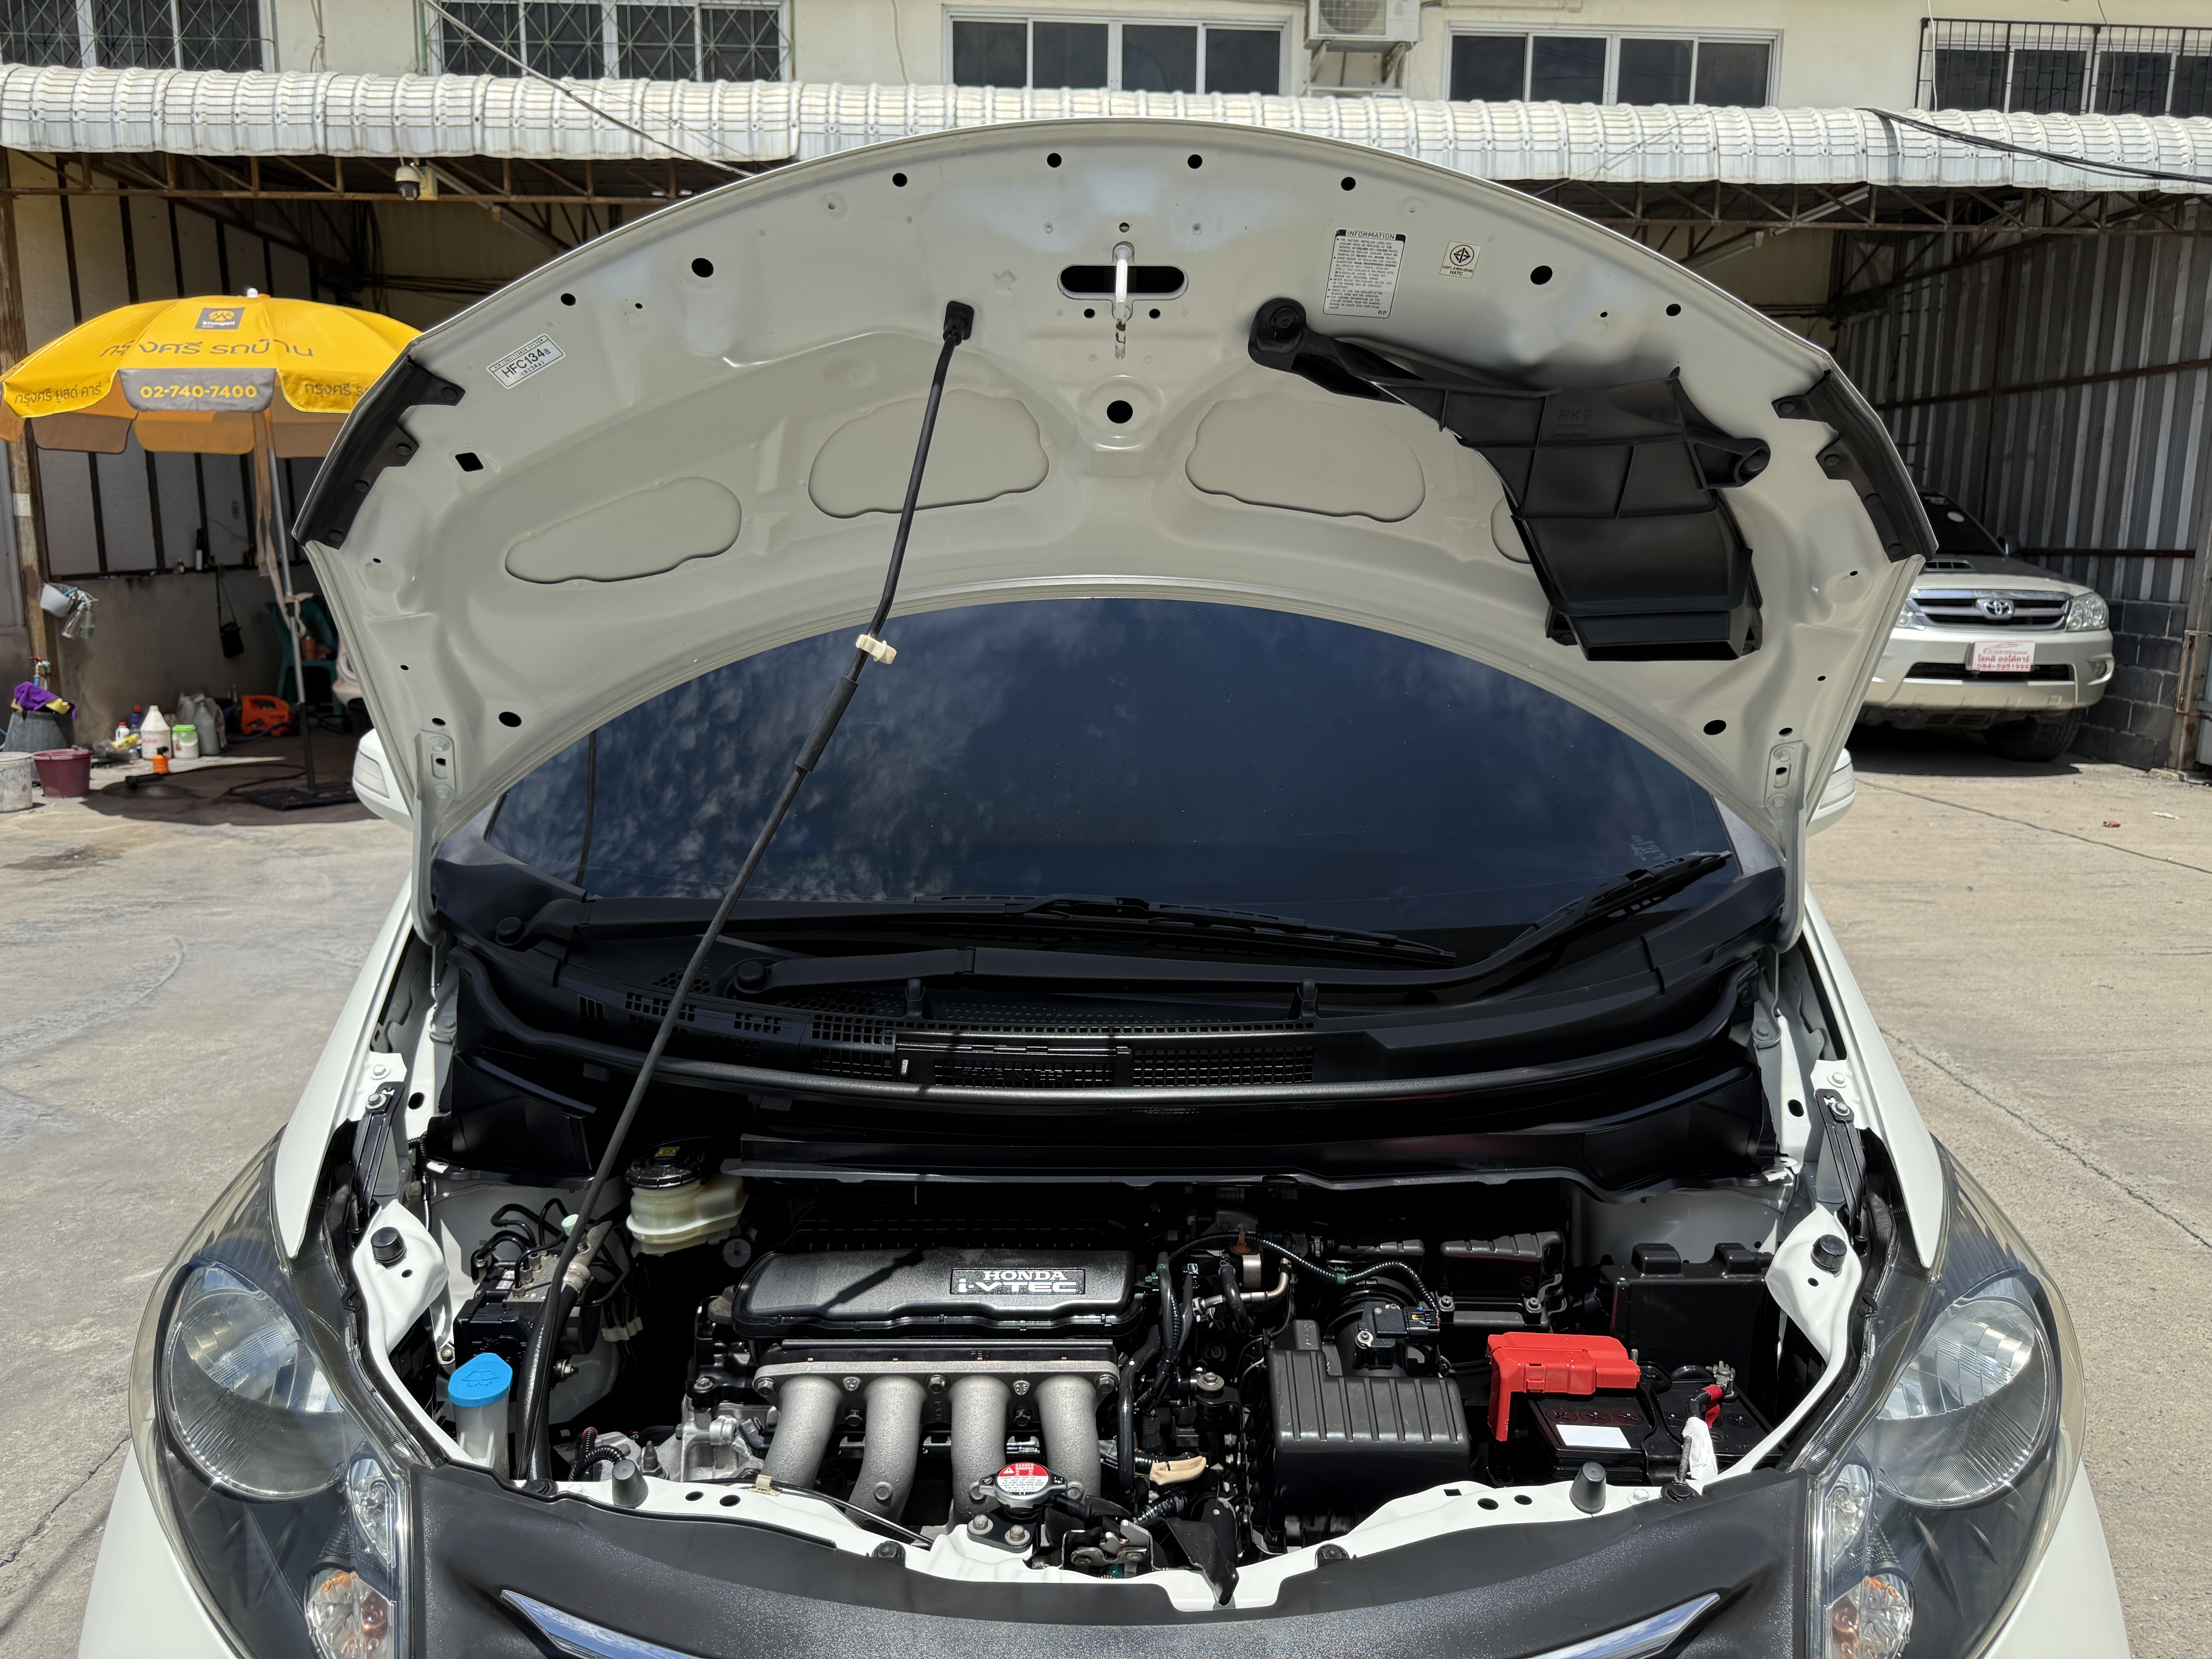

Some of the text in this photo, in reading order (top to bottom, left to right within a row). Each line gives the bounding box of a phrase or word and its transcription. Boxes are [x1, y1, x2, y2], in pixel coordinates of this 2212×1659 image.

[1347, 231, 1395, 239] INFORMATION
[502, 348, 527, 365] CONDITIONER
[528, 338, 544, 349] SYSTEM
[501, 348, 551, 378] HFC134a
[521, 361, 545, 376] (R134a)
[14, 388, 52, 407] กรุงศรี
[81, 381, 102, 397] คาร์
[140, 385, 258, 399] 02-740-7400
[305, 383, 352, 398] กรุงศรี
[1558, 409, 1592, 421] RK9
[983, 1271, 1068, 1281] HONDA
[958, 1278, 1077, 1293] i-VTEC
